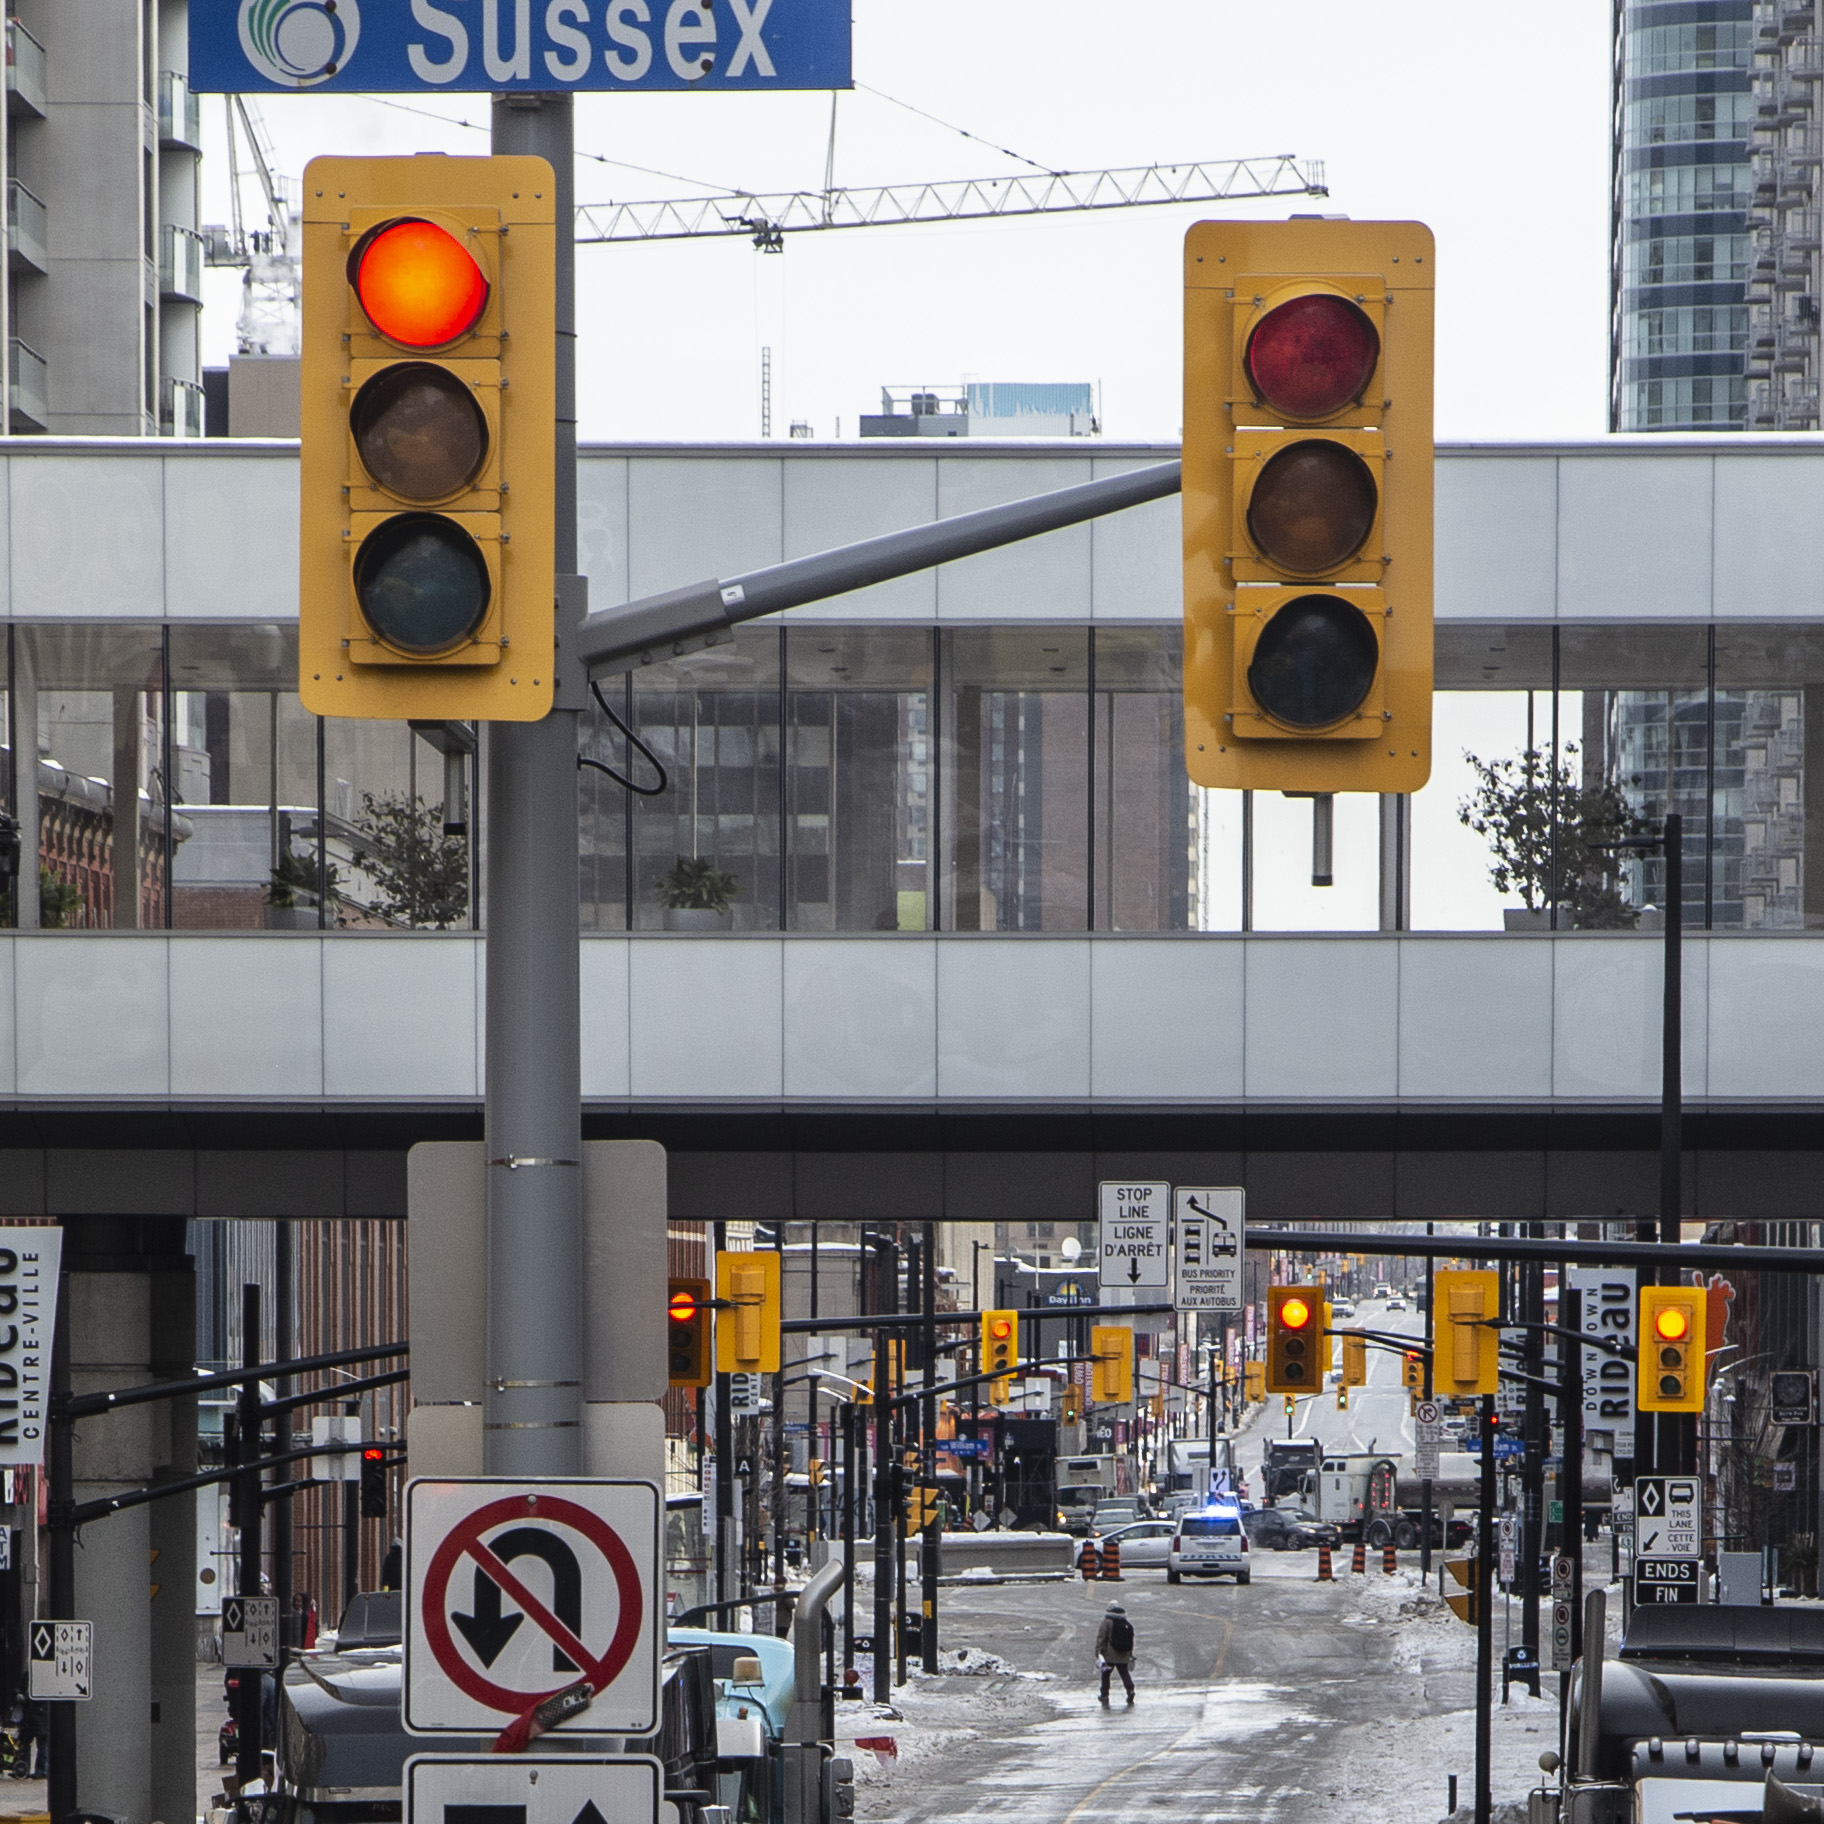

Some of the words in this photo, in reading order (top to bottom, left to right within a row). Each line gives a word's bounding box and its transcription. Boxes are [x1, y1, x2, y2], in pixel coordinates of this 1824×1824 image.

[407, 0, 777, 83] Sussex
[1117, 1188, 1152, 1202] STOP
[1119, 1206, 1150, 1218] LINE
[1114, 1226, 1154, 1239] LIGNE
[1105, 1242, 1162, 1257] D'ARRÊT
[1181, 1269, 1198, 1279] BUS
[1200, 1269, 1236, 1279] PRIORITY
[1189, 1284, 1226, 1295] PRIORITÉ
[1181, 1297, 1197, 1306] AUX
[1200, 1297, 1237, 1306] AUTOBUS
[23, 1251, 39, 1440] CENTRE-VILLE
[1586, 1287, 1598, 1411] DOWNOWN
[731, 1373, 750, 1407] RID
[738, 1460, 750, 1472] A
[1671, 1509, 1692, 1519] THIS
[1669, 1520, 1693, 1529] LANE
[1667, 1534, 1694, 1543] CETTE
[1671, 1544, 1691, 1552] VOIE
[1645, 1563, 1690, 1579] ENDS
[1656, 1586, 1678, 1603] FIN
